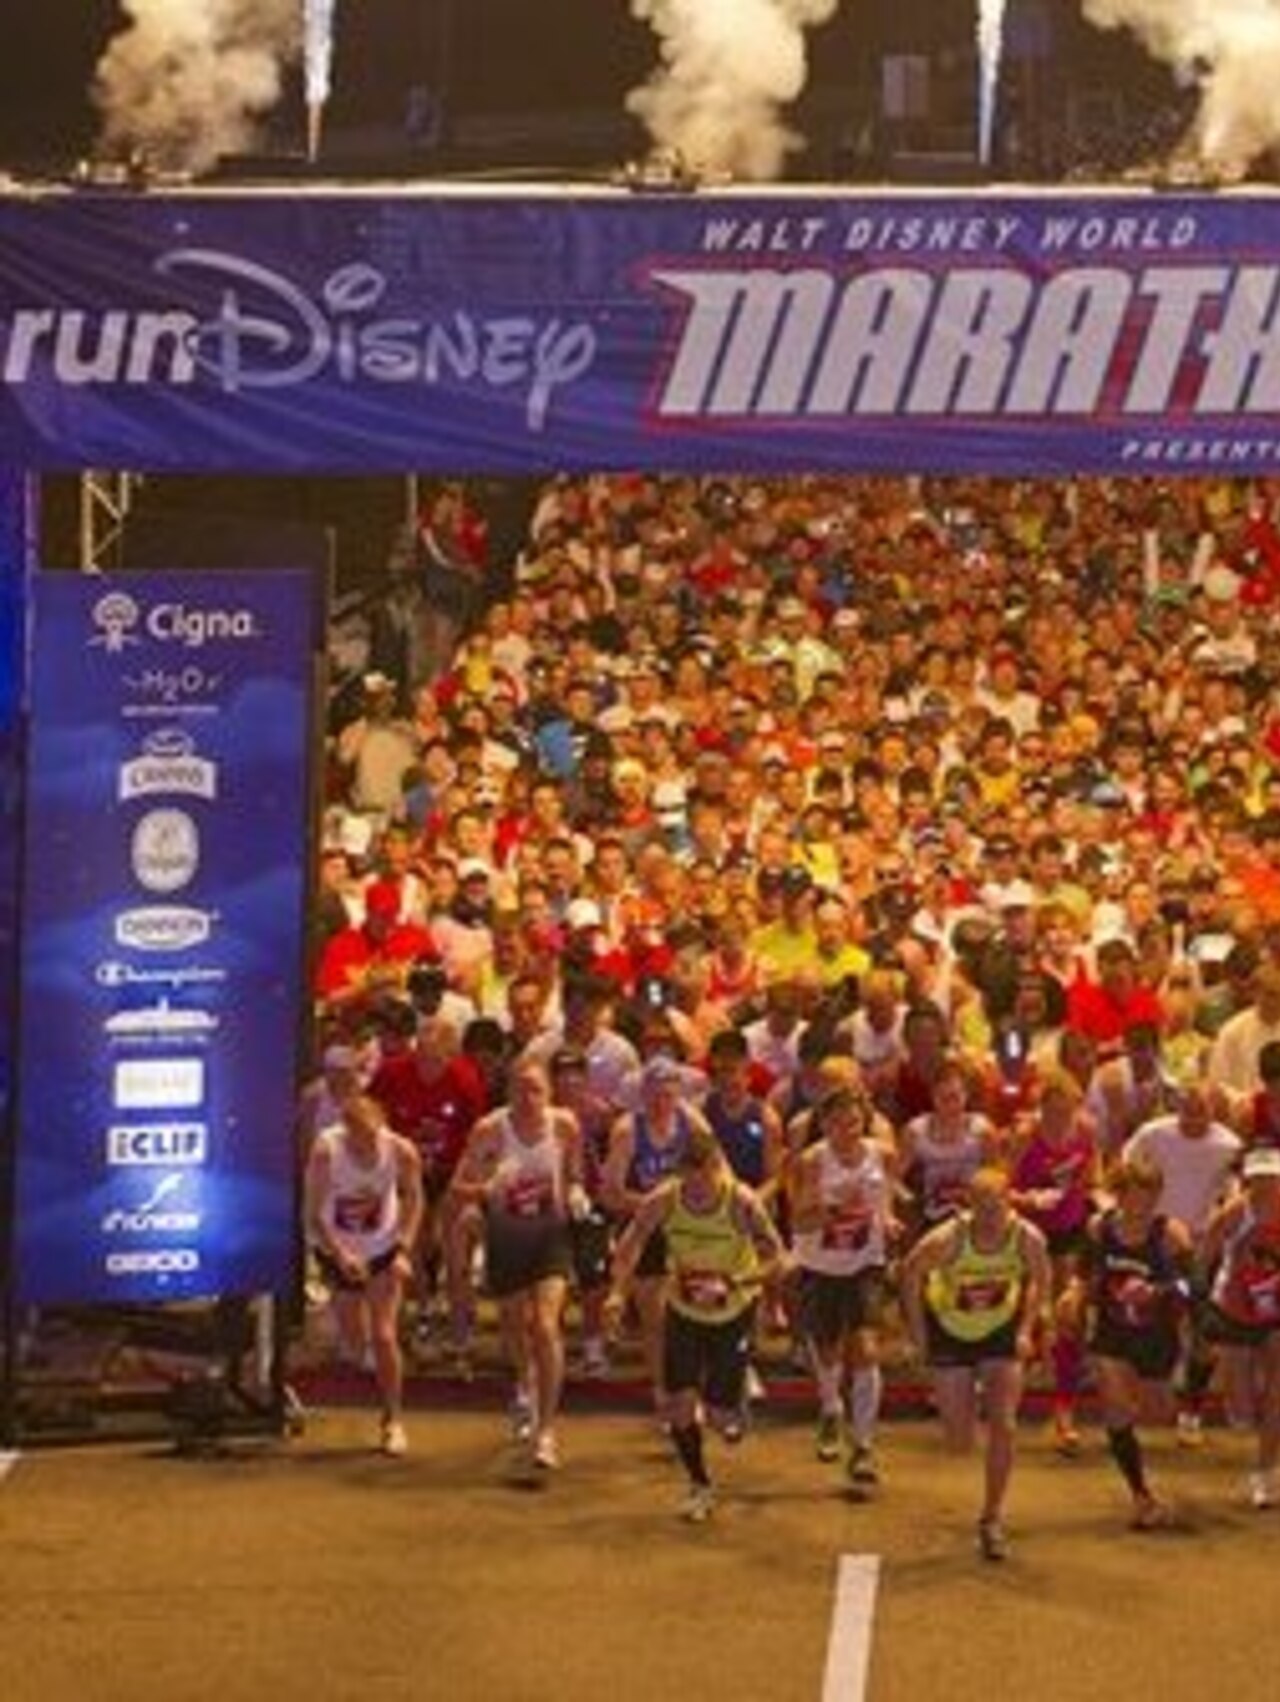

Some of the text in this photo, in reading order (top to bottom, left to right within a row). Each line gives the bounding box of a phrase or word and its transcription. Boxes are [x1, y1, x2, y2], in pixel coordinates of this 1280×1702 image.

[703, 217, 1196, 250] WALT DISNEY WORLD
[147, 604, 252, 648] Cigna
